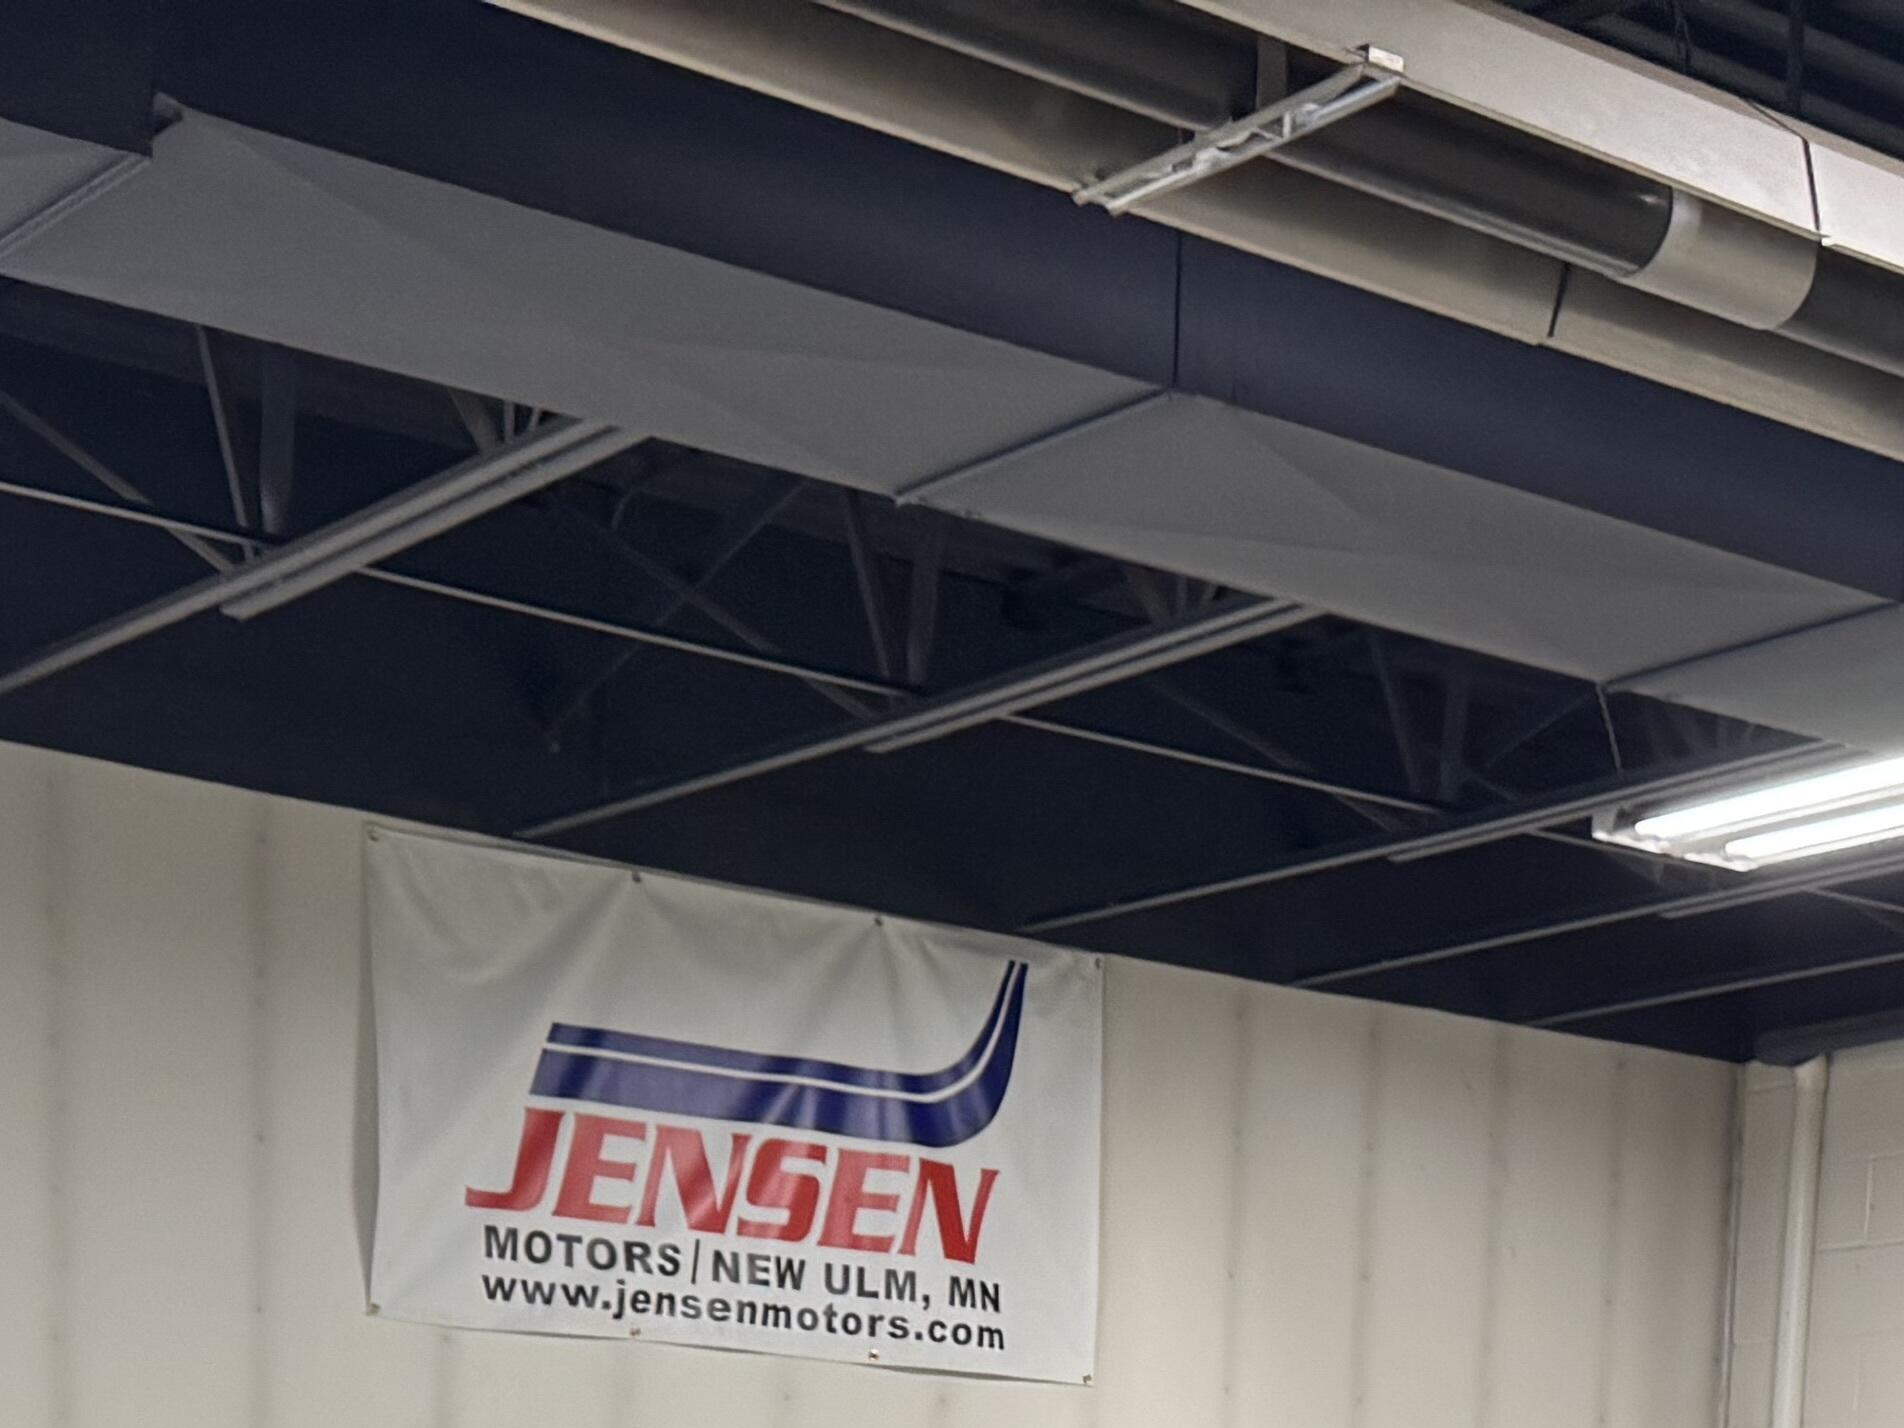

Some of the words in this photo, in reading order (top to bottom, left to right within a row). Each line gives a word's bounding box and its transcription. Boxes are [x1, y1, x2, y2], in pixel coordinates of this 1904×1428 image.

[466, 1108, 999, 1266] JENSEN
[481, 1273, 1006, 1351] www.jensenmotors.com
[484, 1224, 681, 1278] MOTORS
[712, 1248, 806, 1291] NEW
[824, 1262, 931, 1311] ULM,
[948, 1275, 1001, 1314] MN
